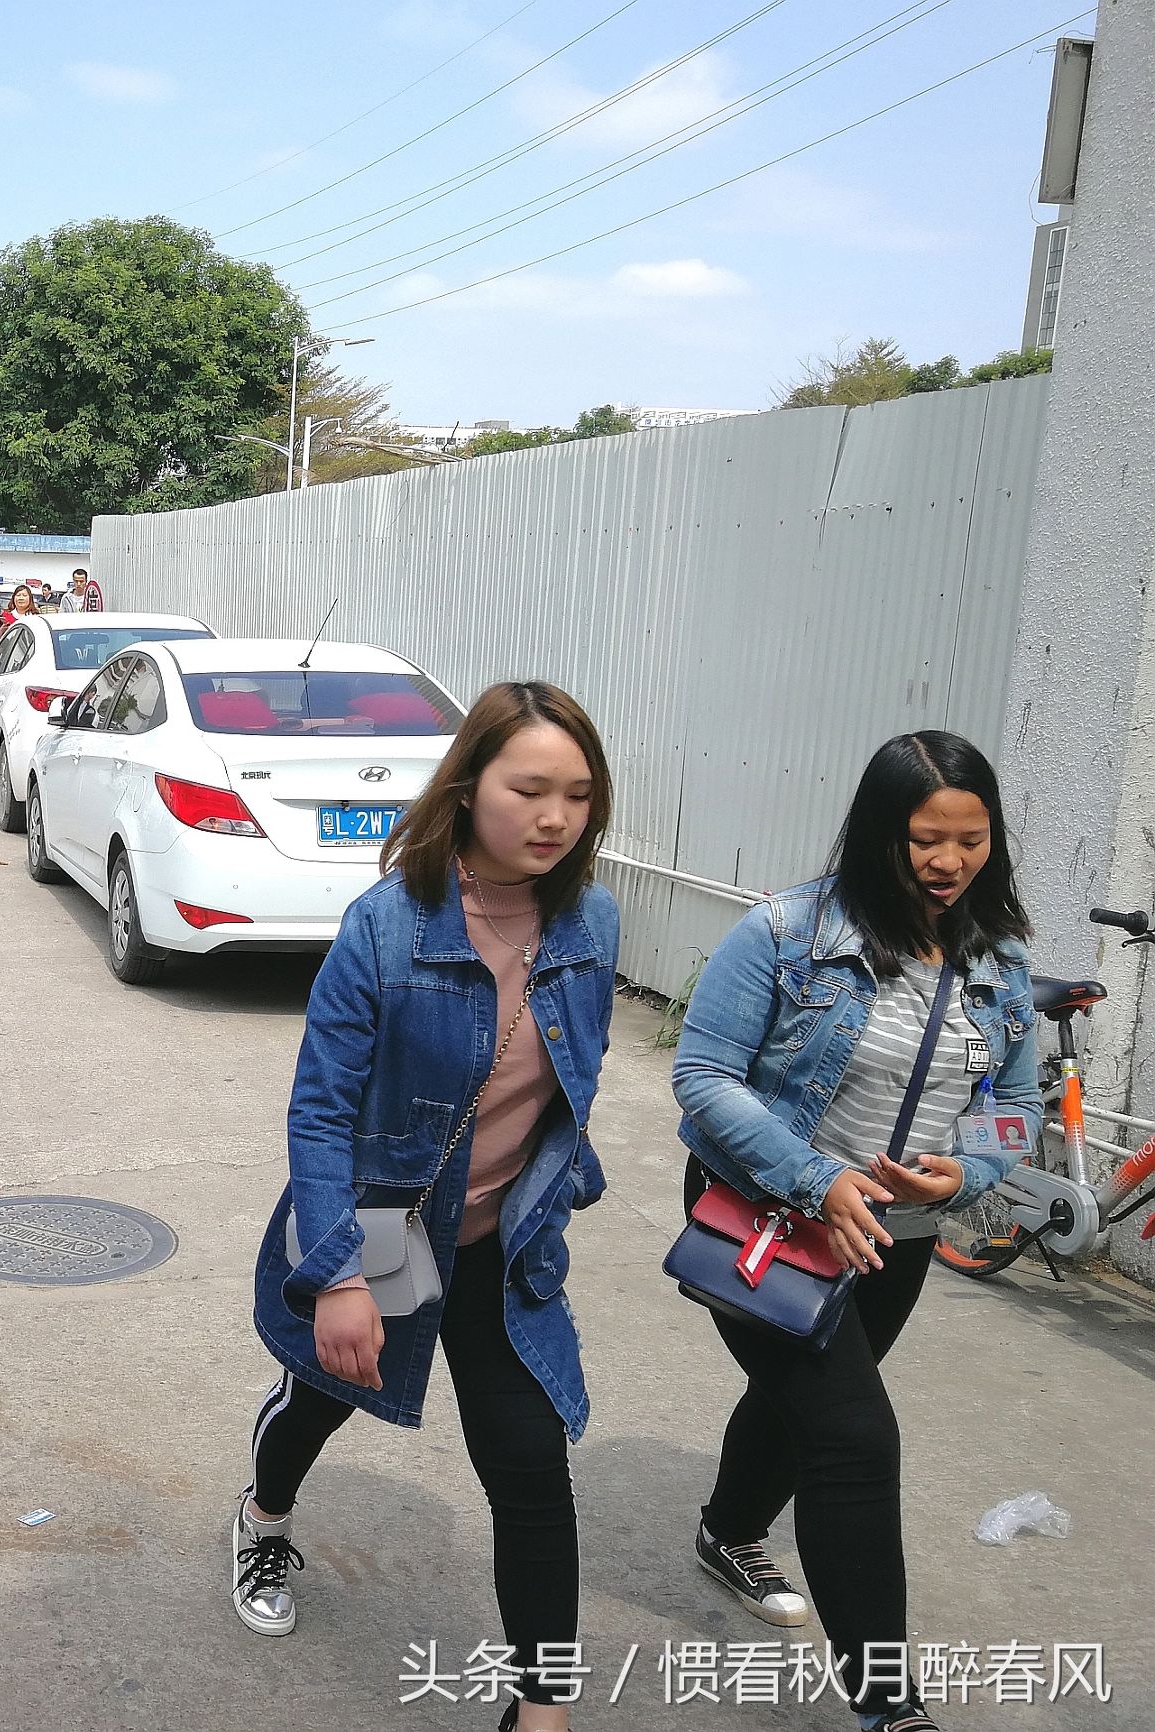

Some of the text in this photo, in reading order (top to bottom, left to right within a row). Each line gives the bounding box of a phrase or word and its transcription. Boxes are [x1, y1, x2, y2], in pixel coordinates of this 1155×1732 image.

[240, 770, 272, 780] 北京现代
[1132, 1136, 1155, 1167] mo
